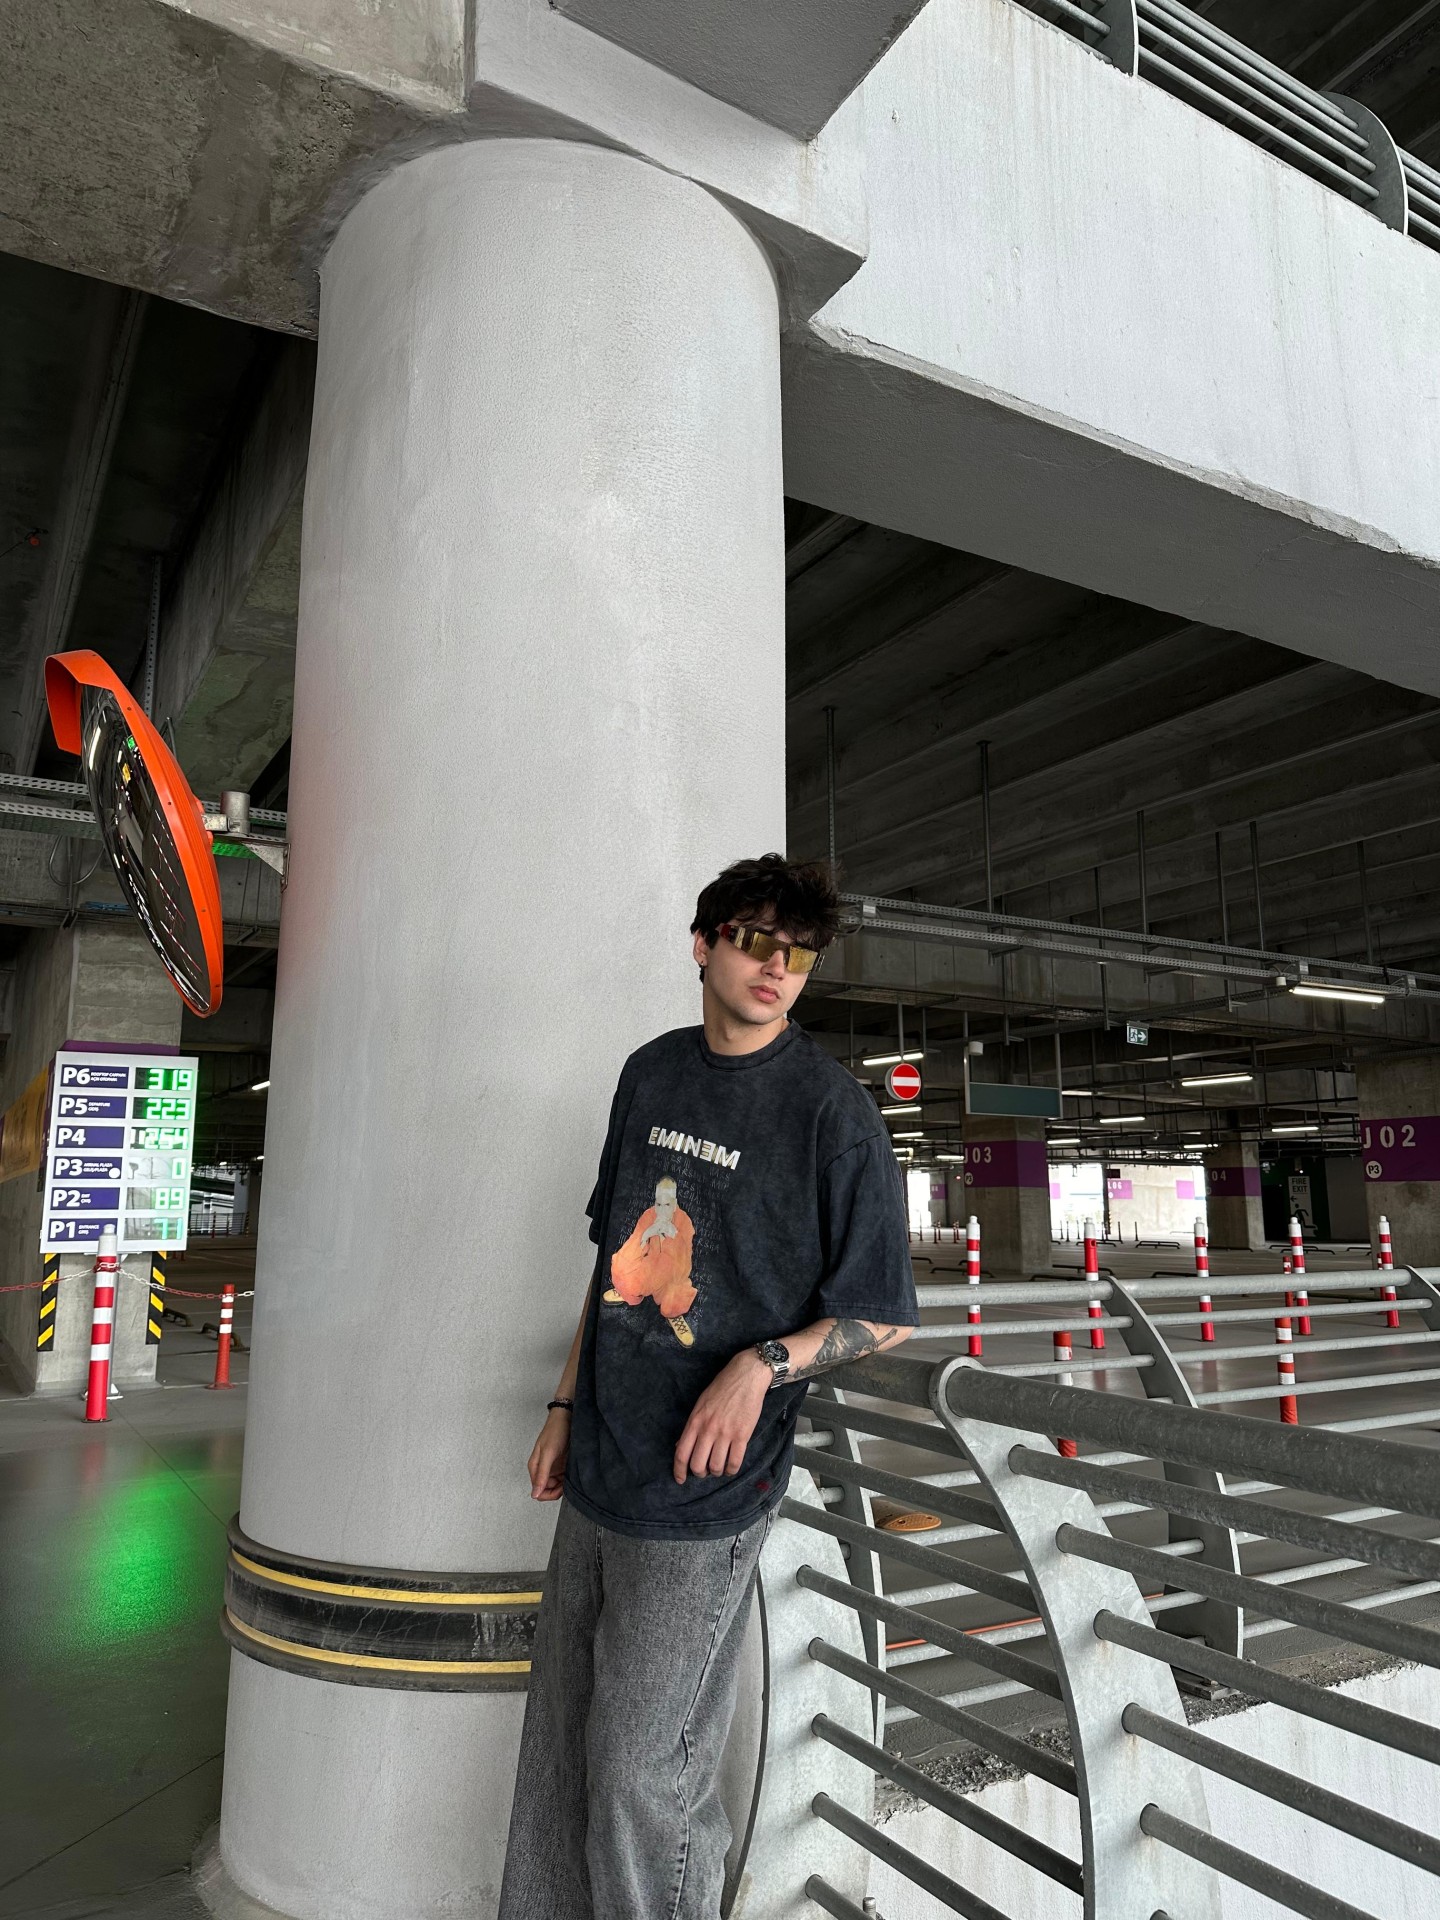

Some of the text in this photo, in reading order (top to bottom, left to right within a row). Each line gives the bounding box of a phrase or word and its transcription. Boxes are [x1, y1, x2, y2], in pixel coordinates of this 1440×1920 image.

[62, 1066, 91, 1085] P6
[148, 1068, 193, 1090] 319
[60, 1097, 88, 1115] P5
[146, 1097, 190, 1120] 223
[57, 1127, 86, 1145] P4
[55, 1158, 83, 1176] P3
[172, 1158, 186, 1179] 0
[1368, 1164, 1380, 1174] P3
[1291, 1177, 1307, 1185] FIRE
[1292, 1185, 1308, 1193] EXIT
[52, 1189, 80, 1208] P2
[155, 1188, 184, 1210] 89
[50, 1220, 76, 1239] P1
[153, 1217, 183, 1240] 71
